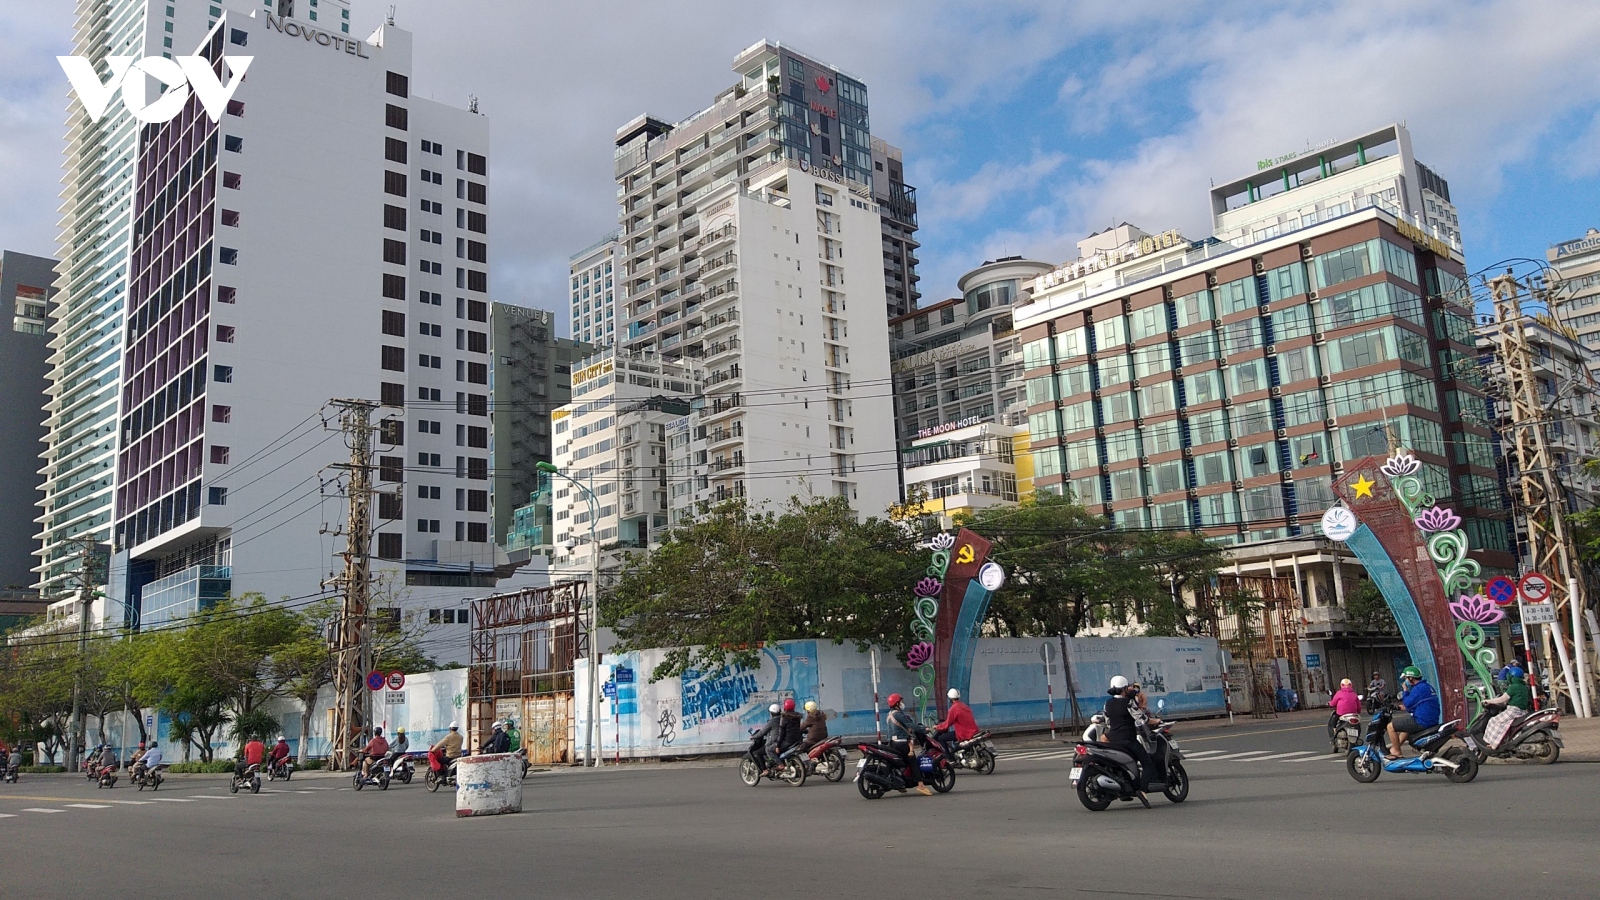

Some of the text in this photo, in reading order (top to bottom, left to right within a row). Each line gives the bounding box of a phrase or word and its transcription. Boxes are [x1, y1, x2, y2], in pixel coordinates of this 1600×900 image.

[267, 12, 369, 59] NOVOTEL
[810, 100, 837, 119] MAPLE
[811, 165, 841, 184] BOSS
[1257, 158, 1274, 171] ibis
[1034, 228, 1181, 292] HAPPY LIGHT HOTEL
[503, 305, 540, 320] VENUE
[573, 362, 603, 386] SUN CITY
[918, 415, 981, 439] THE MOON HOTEL
